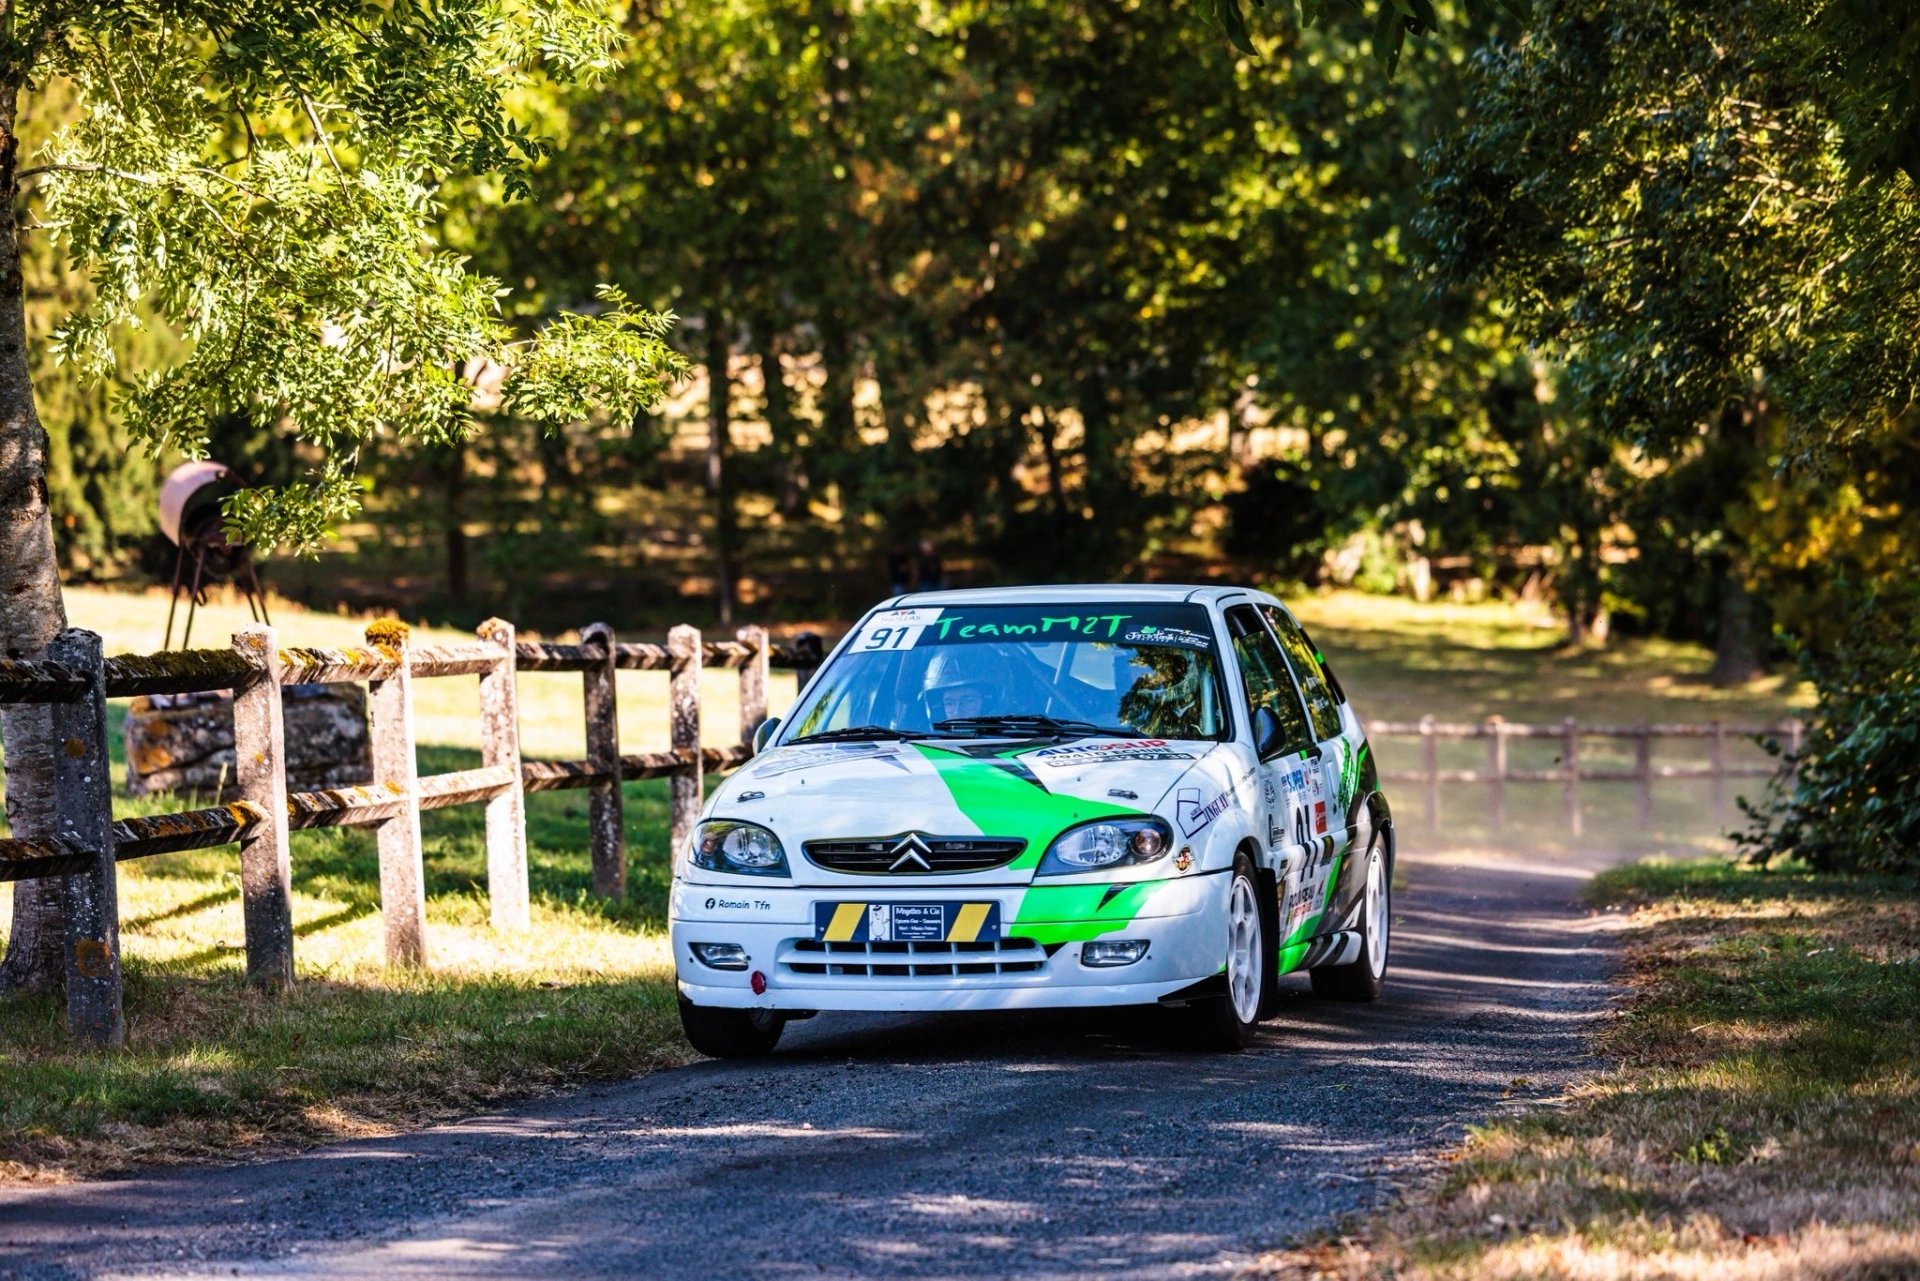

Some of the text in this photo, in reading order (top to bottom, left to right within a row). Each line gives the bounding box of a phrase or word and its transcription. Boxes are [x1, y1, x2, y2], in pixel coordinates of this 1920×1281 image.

[865, 627, 906, 650] 91
[1036, 740, 1170, 757] AUTOSUR
[718, 899, 771, 910] Romain Tfn
